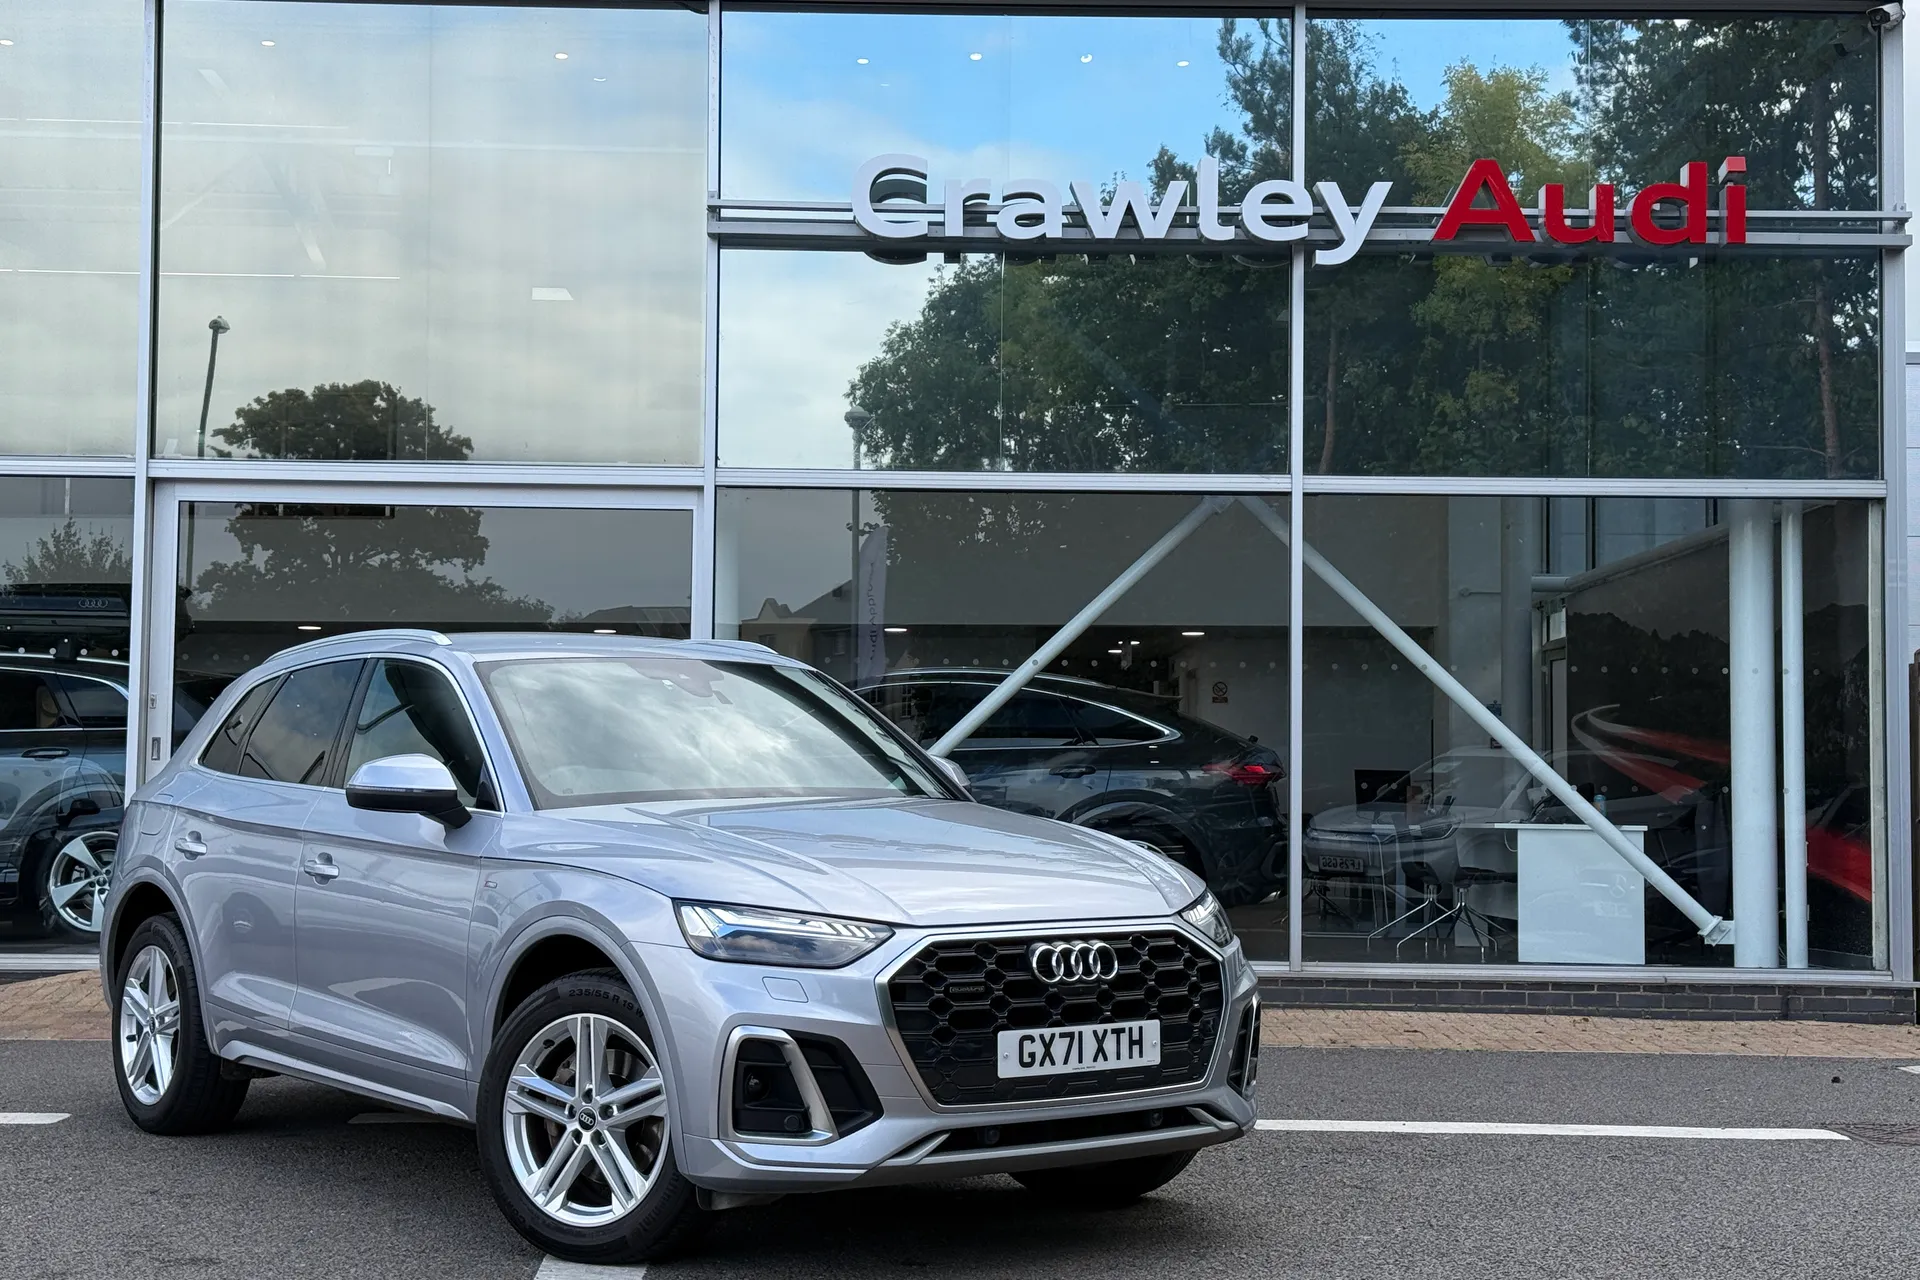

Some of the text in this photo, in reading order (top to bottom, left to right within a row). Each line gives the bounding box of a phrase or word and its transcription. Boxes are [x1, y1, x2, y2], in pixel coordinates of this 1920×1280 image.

[853, 153, 1747, 265] Crawley Audi
[568, 988, 610, 999] 235/55
[612, 994, 621, 1004] R
[622, 999, 634, 1010] 19
[1018, 1026, 1144, 1068] GX71 XTH
